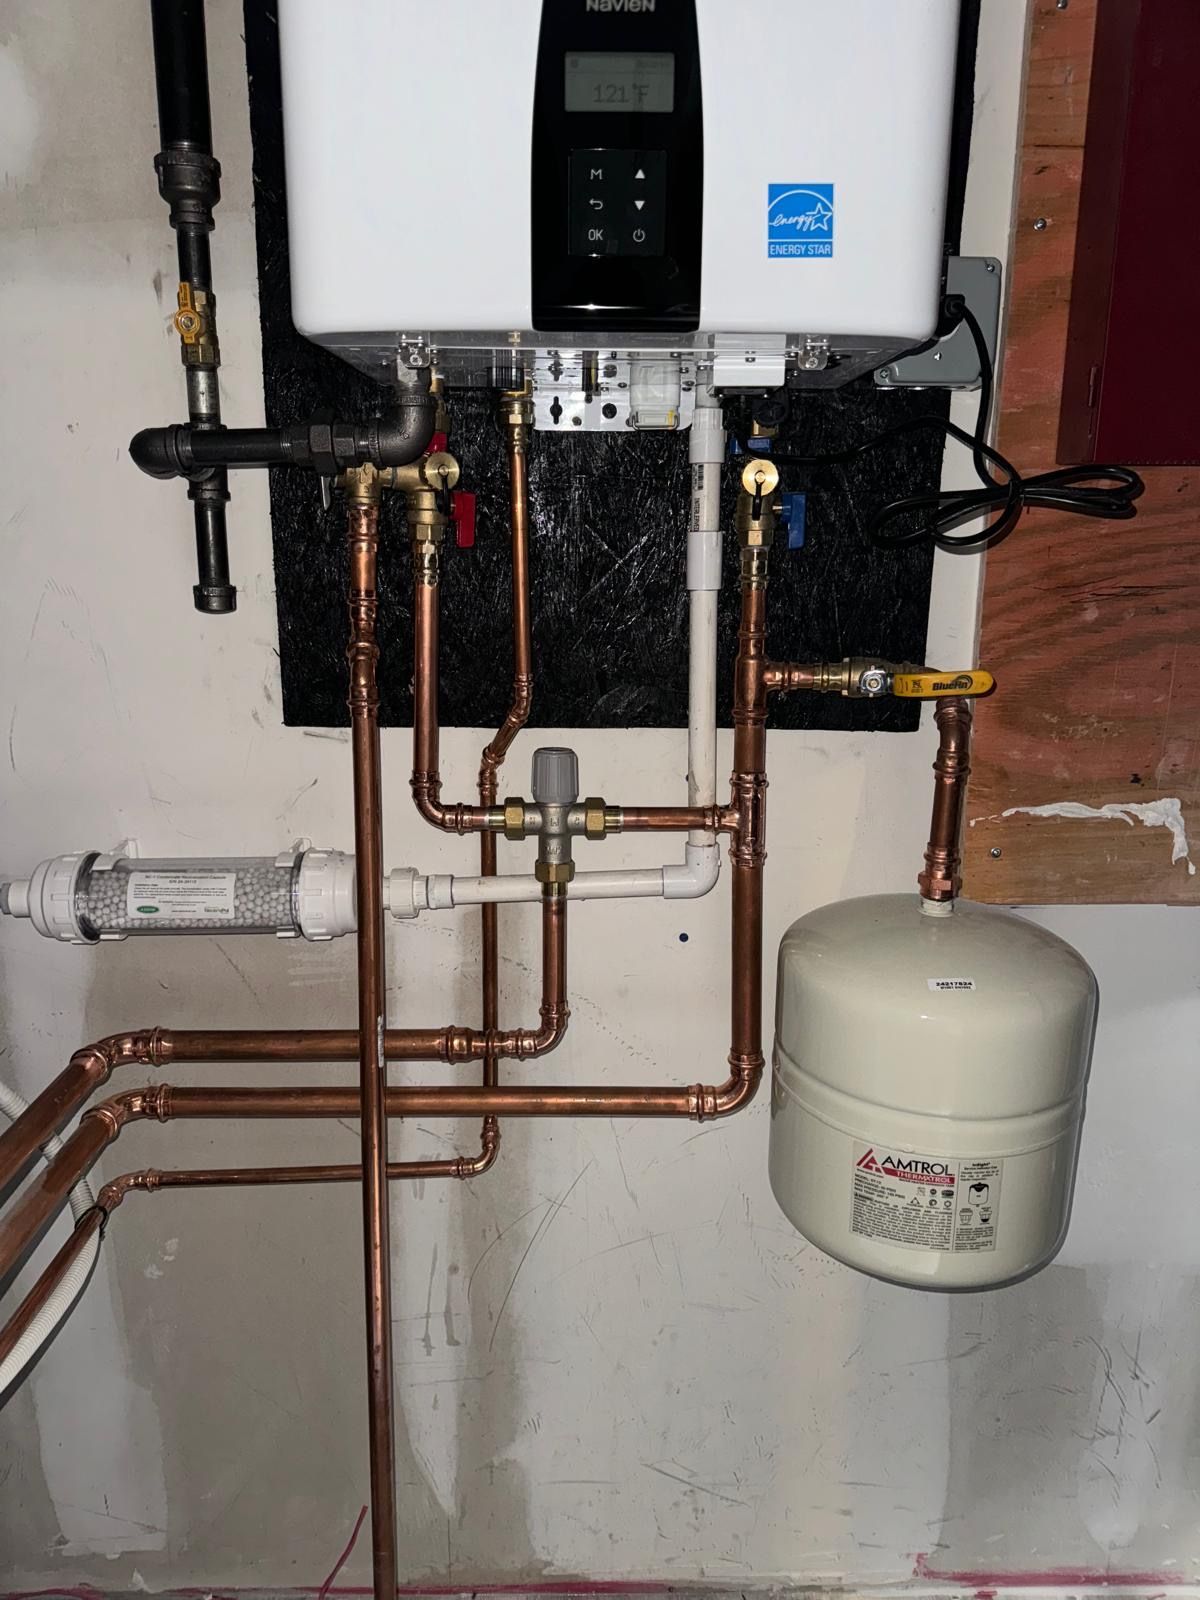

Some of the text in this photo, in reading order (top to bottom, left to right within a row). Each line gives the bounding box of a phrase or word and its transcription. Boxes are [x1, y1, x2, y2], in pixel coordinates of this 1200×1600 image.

[590, 168, 603, 180] M
[588, 228, 603, 241] OK
[769, 244, 831, 255] ENERGY STAR
[881, 1155, 953, 1176] AMTROL
